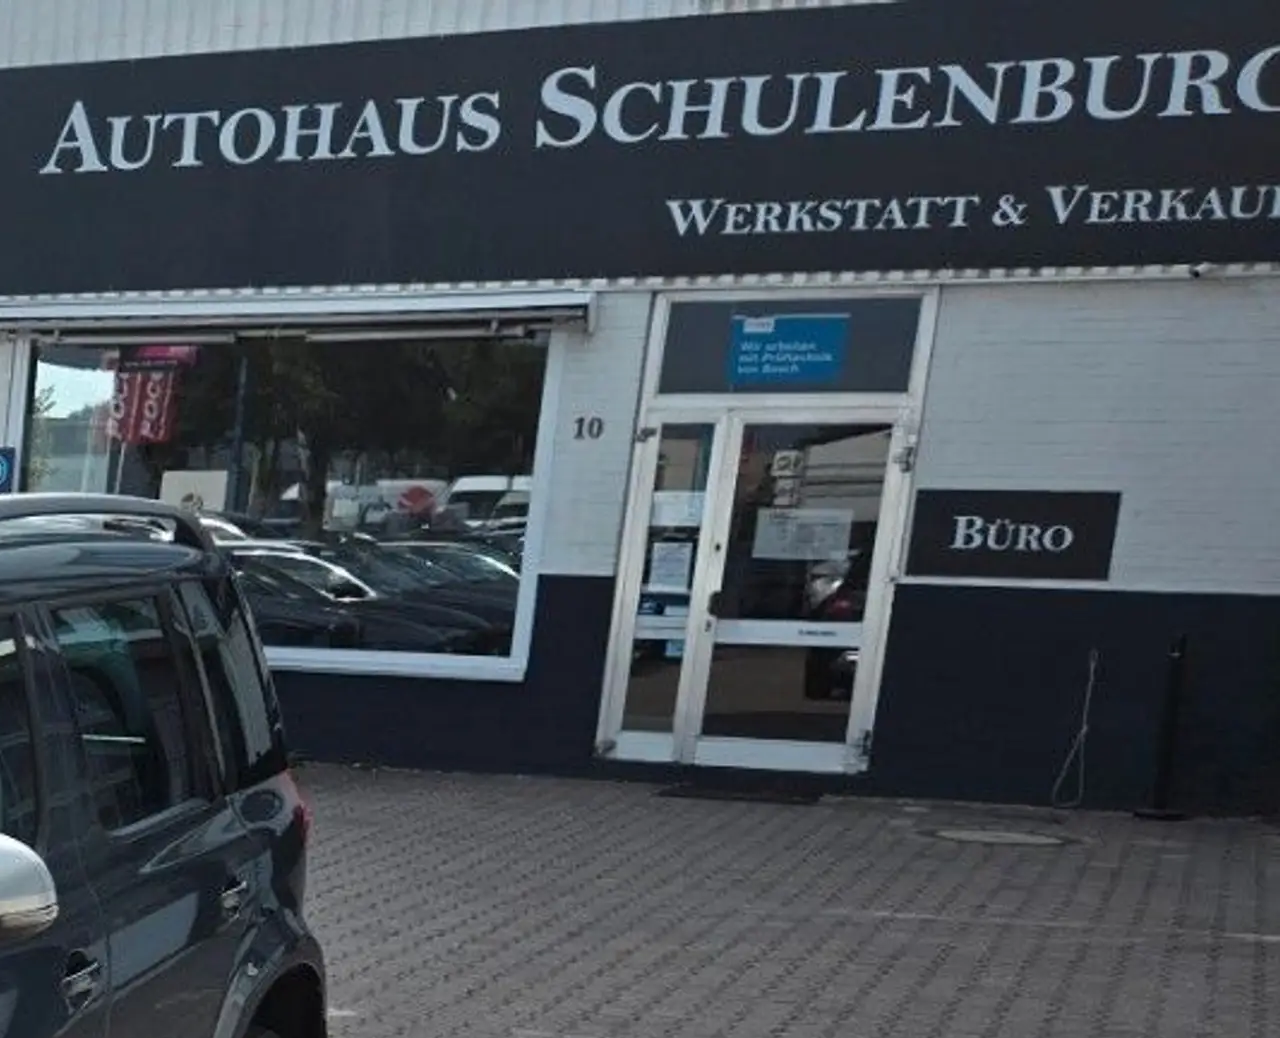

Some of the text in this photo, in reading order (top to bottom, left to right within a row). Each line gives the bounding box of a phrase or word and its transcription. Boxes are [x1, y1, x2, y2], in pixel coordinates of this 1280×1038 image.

[40, 93, 500, 173] AUTOHAUS
[667, 186, 1280, 235] WERKSTATT & VERKAU
[573, 416, 605, 440] 10
[950, 515, 1075, 552] BÜRO
